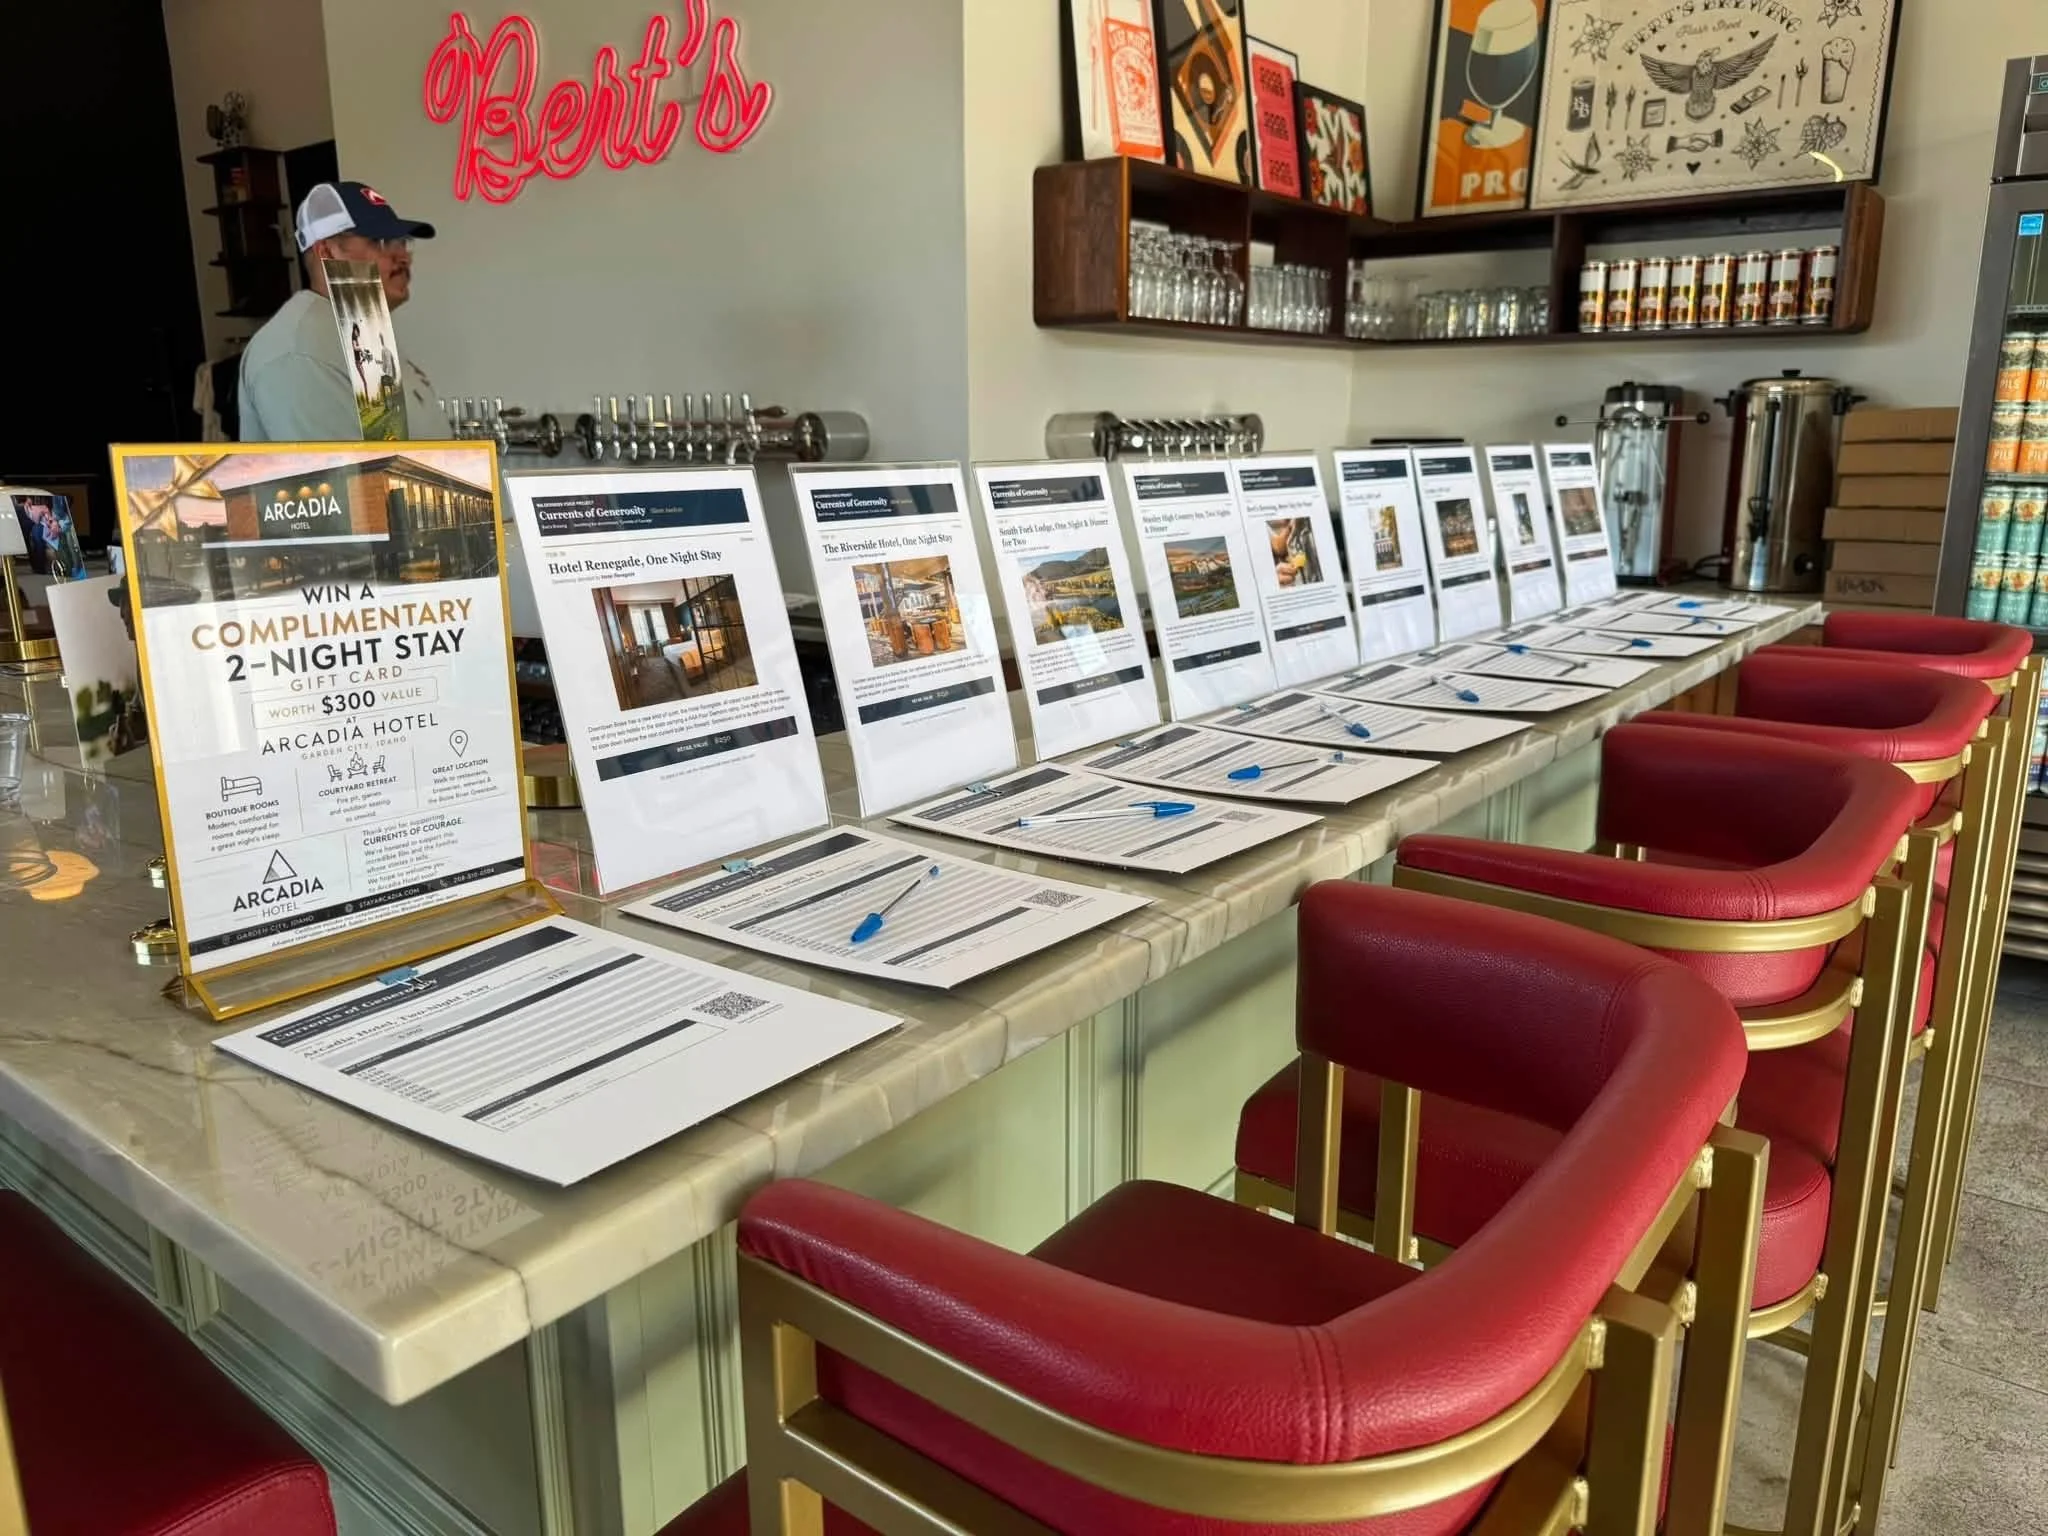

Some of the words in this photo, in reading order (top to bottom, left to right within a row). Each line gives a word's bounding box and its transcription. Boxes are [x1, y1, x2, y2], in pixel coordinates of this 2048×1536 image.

[1622, 0, 1695, 54] BERT'S
[424, 0, 772, 204] Bert's
[264, 496, 341, 522] ARCADIA
[539, 509, 584, 521] Currents
[585, 507, 596, 519] of
[597, 504, 646, 520] Generosity
[815, 500, 846, 510] Currents
[846, 499, 853, 508] of
[853, 497, 888, 508] Generosity
[291, 520, 310, 531] HOTEL
[822, 543, 839, 555] The
[840, 538, 878, 553] Riverside
[879, 537, 902, 550] Hotel,
[903, 538, 917, 547] One
[918, 534, 937, 546] Night
[938, 533, 953, 544] Stay
[548, 560, 583, 575] Hotel
[586, 555, 645, 572] Renegade,
[646, 554, 668, 565] One
[671, 550, 699, 564] Night
[701, 549, 722, 562] Stay
[302, 585, 350, 605] WIN
[359, 583, 375, 600] A
[192, 597, 473, 651] COMPLIMENTARY
[226, 637, 382, 682] 2-NIGHT
[395, 627, 465, 661] STAY
[291, 674, 338, 692] GIFT
[349, 665, 403, 684] CARD
[269, 703, 315, 719] WORTH
[321, 689, 377, 716] $300
[381, 687, 423, 702] VALUE
[346, 716, 358, 725] AT
[261, 725, 364, 756] ARCADIA
[373, 713, 439, 735] HOTEL
[301, 746, 345, 760] GARDEN
[376, 736, 407, 747] IDAHO
[432, 764, 455, 775] GREAT
[455, 758, 489, 771] LOCATION
[318, 782, 365, 797] COURTYARD
[366, 776, 397, 788] RETREAT
[205, 805, 249, 820] BOUTIQUE
[250, 799, 279, 812] ROOMS
[239, 811, 279, 826] comfortable
[236, 823, 268, 836] designed
[362, 827, 381, 836] Thank
[410, 812, 444, 826] supporting
[362, 829, 408, 846] CURRENTS
[409, 826, 421, 835] OF
[233, 877, 324, 912] ARCADIA
[262, 901, 300, 918] HOTEL
[236, 927, 269, 941] GARDEN
[290, 915, 315, 927] IDAHO
[273, 1013, 342, 1042] Currents
[345, 1005, 360, 1015] of
